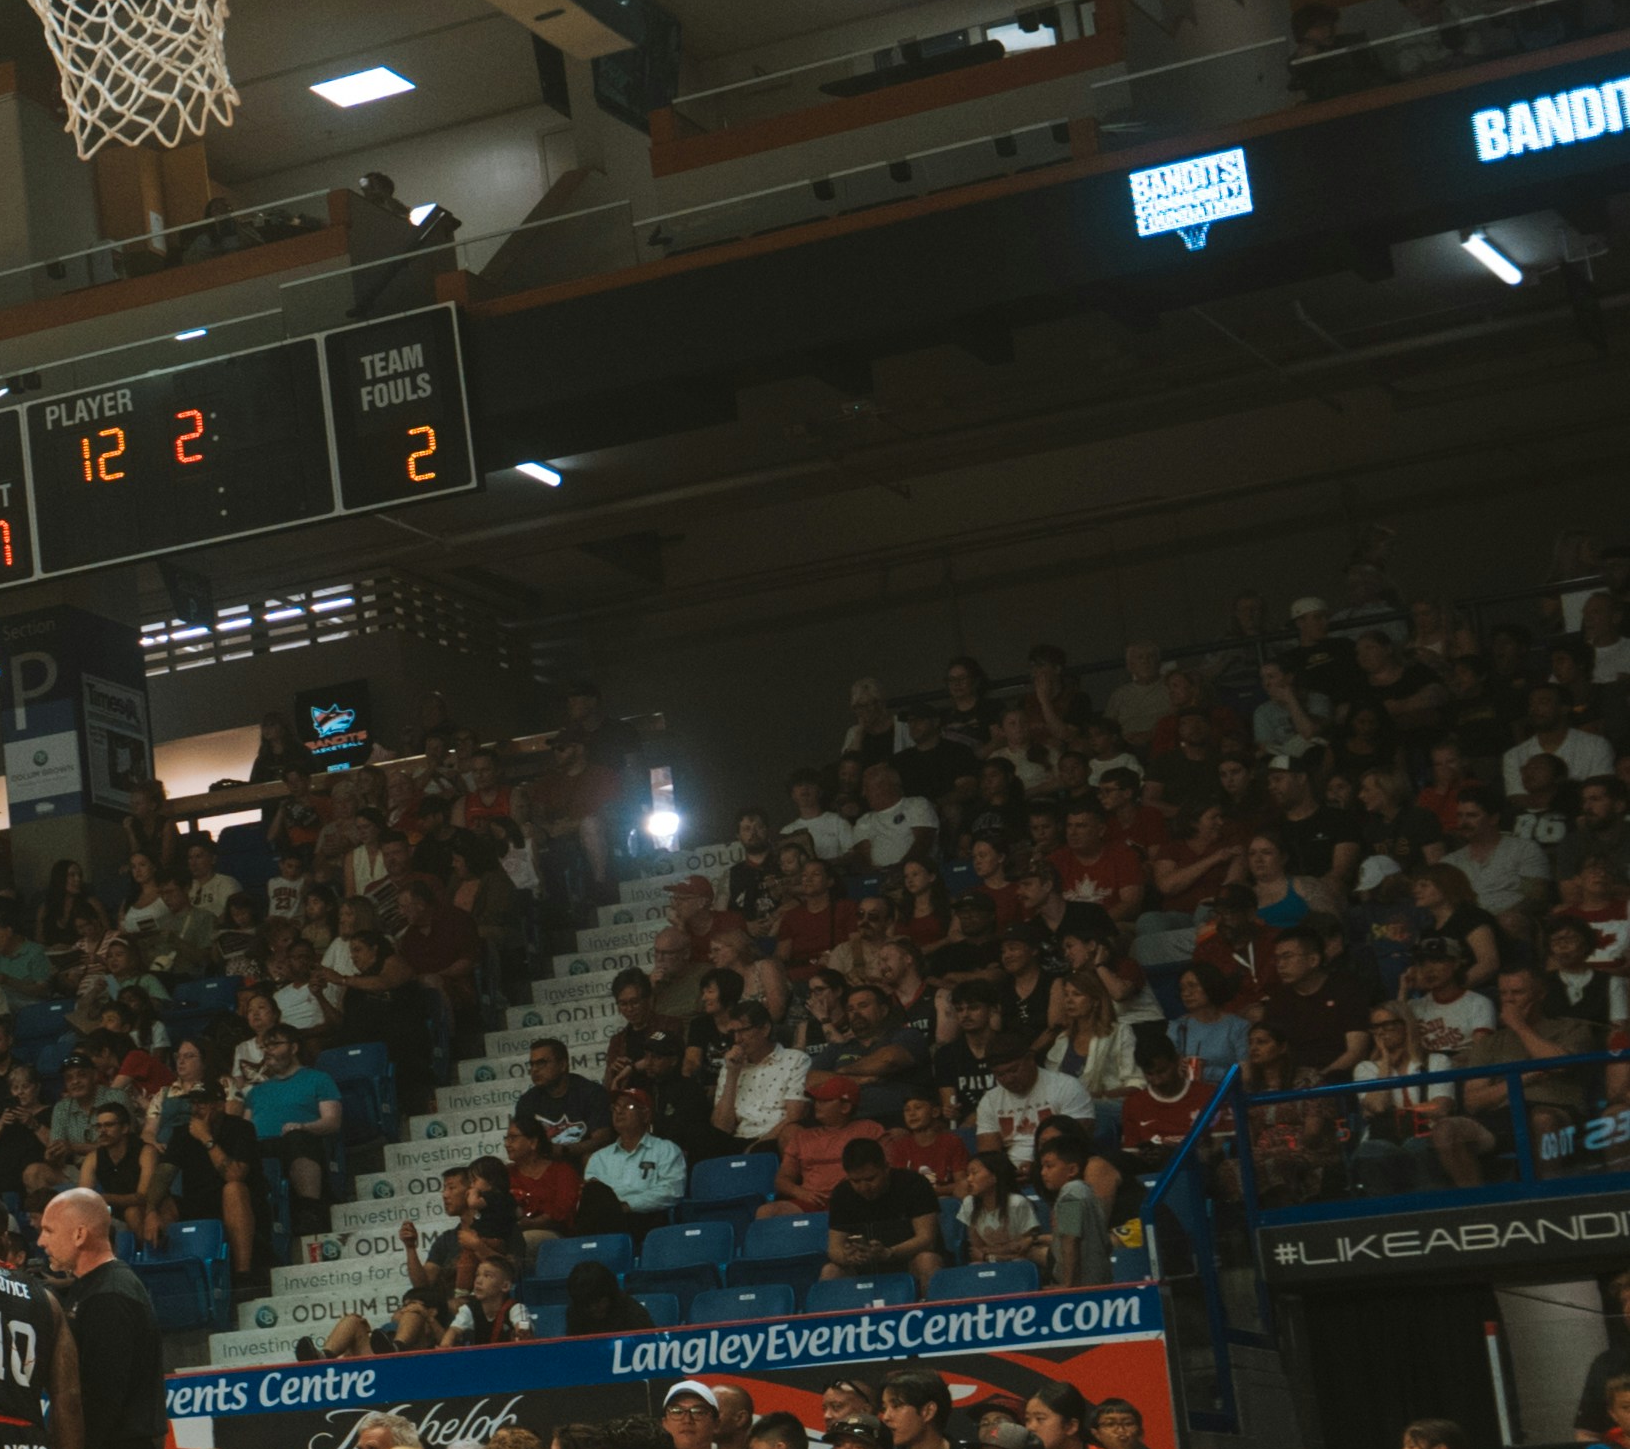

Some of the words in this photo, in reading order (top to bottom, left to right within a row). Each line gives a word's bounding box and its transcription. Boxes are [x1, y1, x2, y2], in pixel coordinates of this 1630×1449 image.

[360, 343, 425, 381] TEAM
[45, 388, 134, 431] PLAYER
[360, 373, 432, 412] FOULS
[81, 427, 125, 482] 12
[175, 409, 204, 464] 2
[407, 425, 437, 482] 2
[2, 617, 56, 640] Section
[12, 650, 58, 731] P
[306, 730, 367, 752] BANDITS
[397, 1144, 471, 1168] Investing
[477, 1138, 502, 1157] for
[343, 1201, 420, 1227] Investing
[284, 1268, 361, 1292] Investing
[368, 1265, 395, 1282] for
[222, 1335, 299, 1358] Investing
[611, 1293, 1142, 1376] LangleyEventsCentre.com
[259, 1367, 376, 1407] Centre
